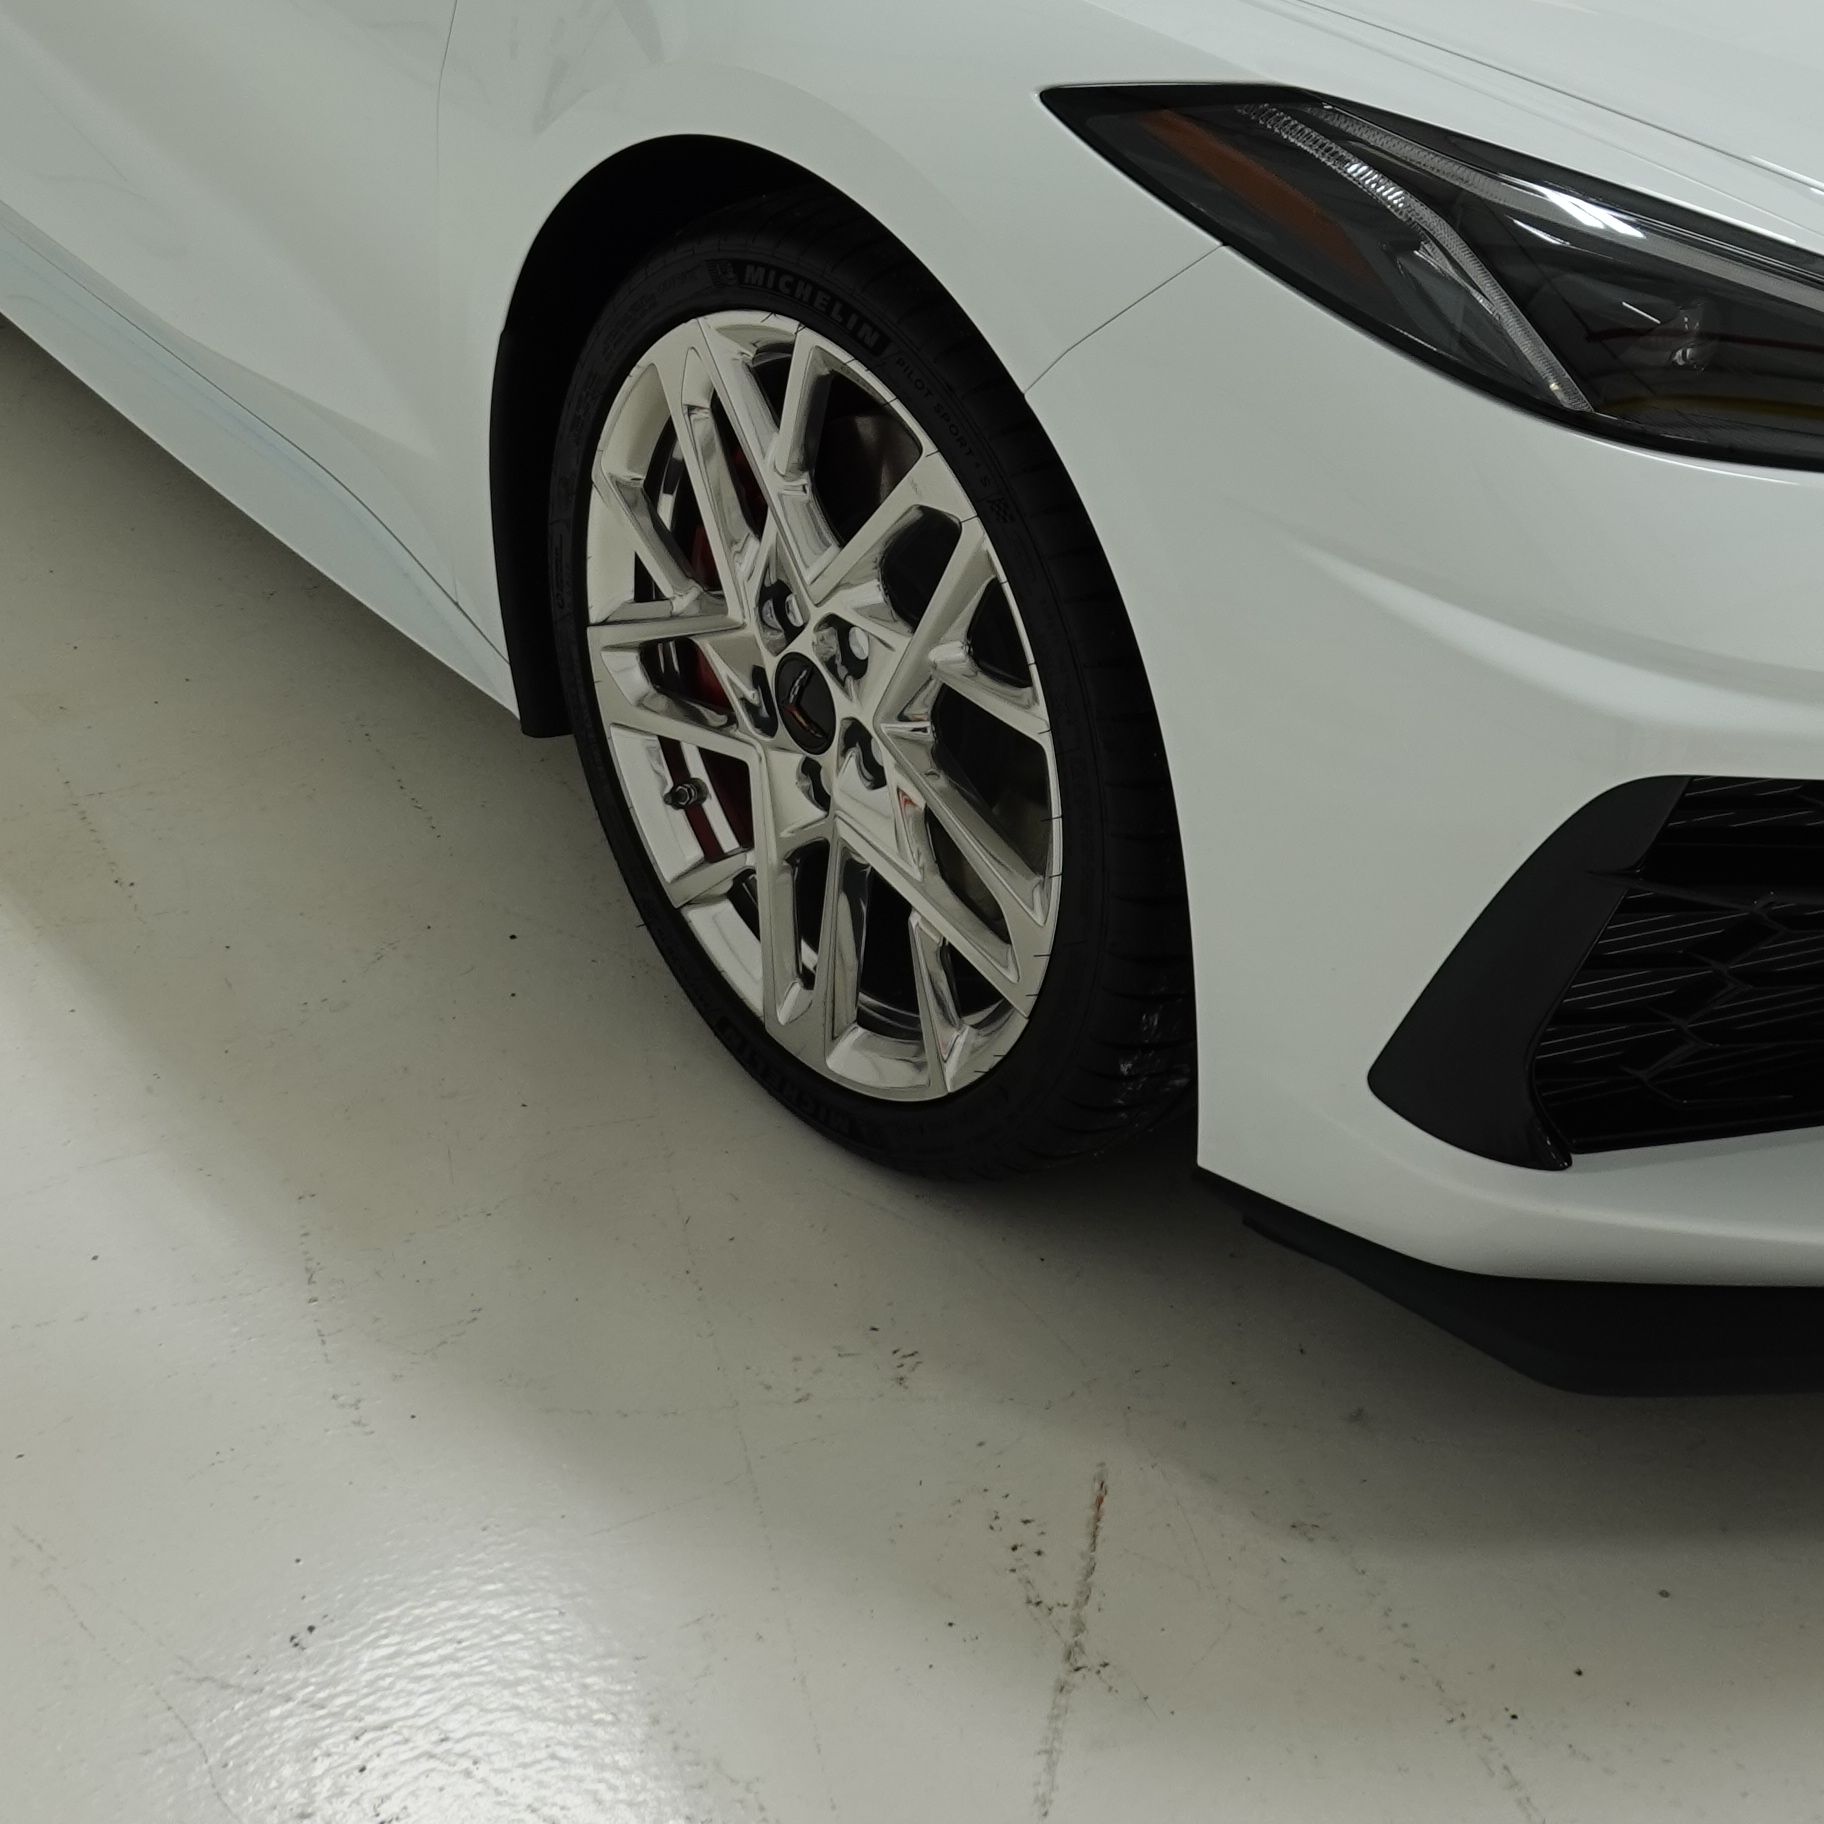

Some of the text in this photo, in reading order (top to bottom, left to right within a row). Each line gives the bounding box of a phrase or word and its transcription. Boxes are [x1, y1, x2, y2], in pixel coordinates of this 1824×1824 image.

[743, 263, 881, 348] MICHELIN
[895, 357, 934, 399] PILOT
[933, 402, 975, 457] SPORT
